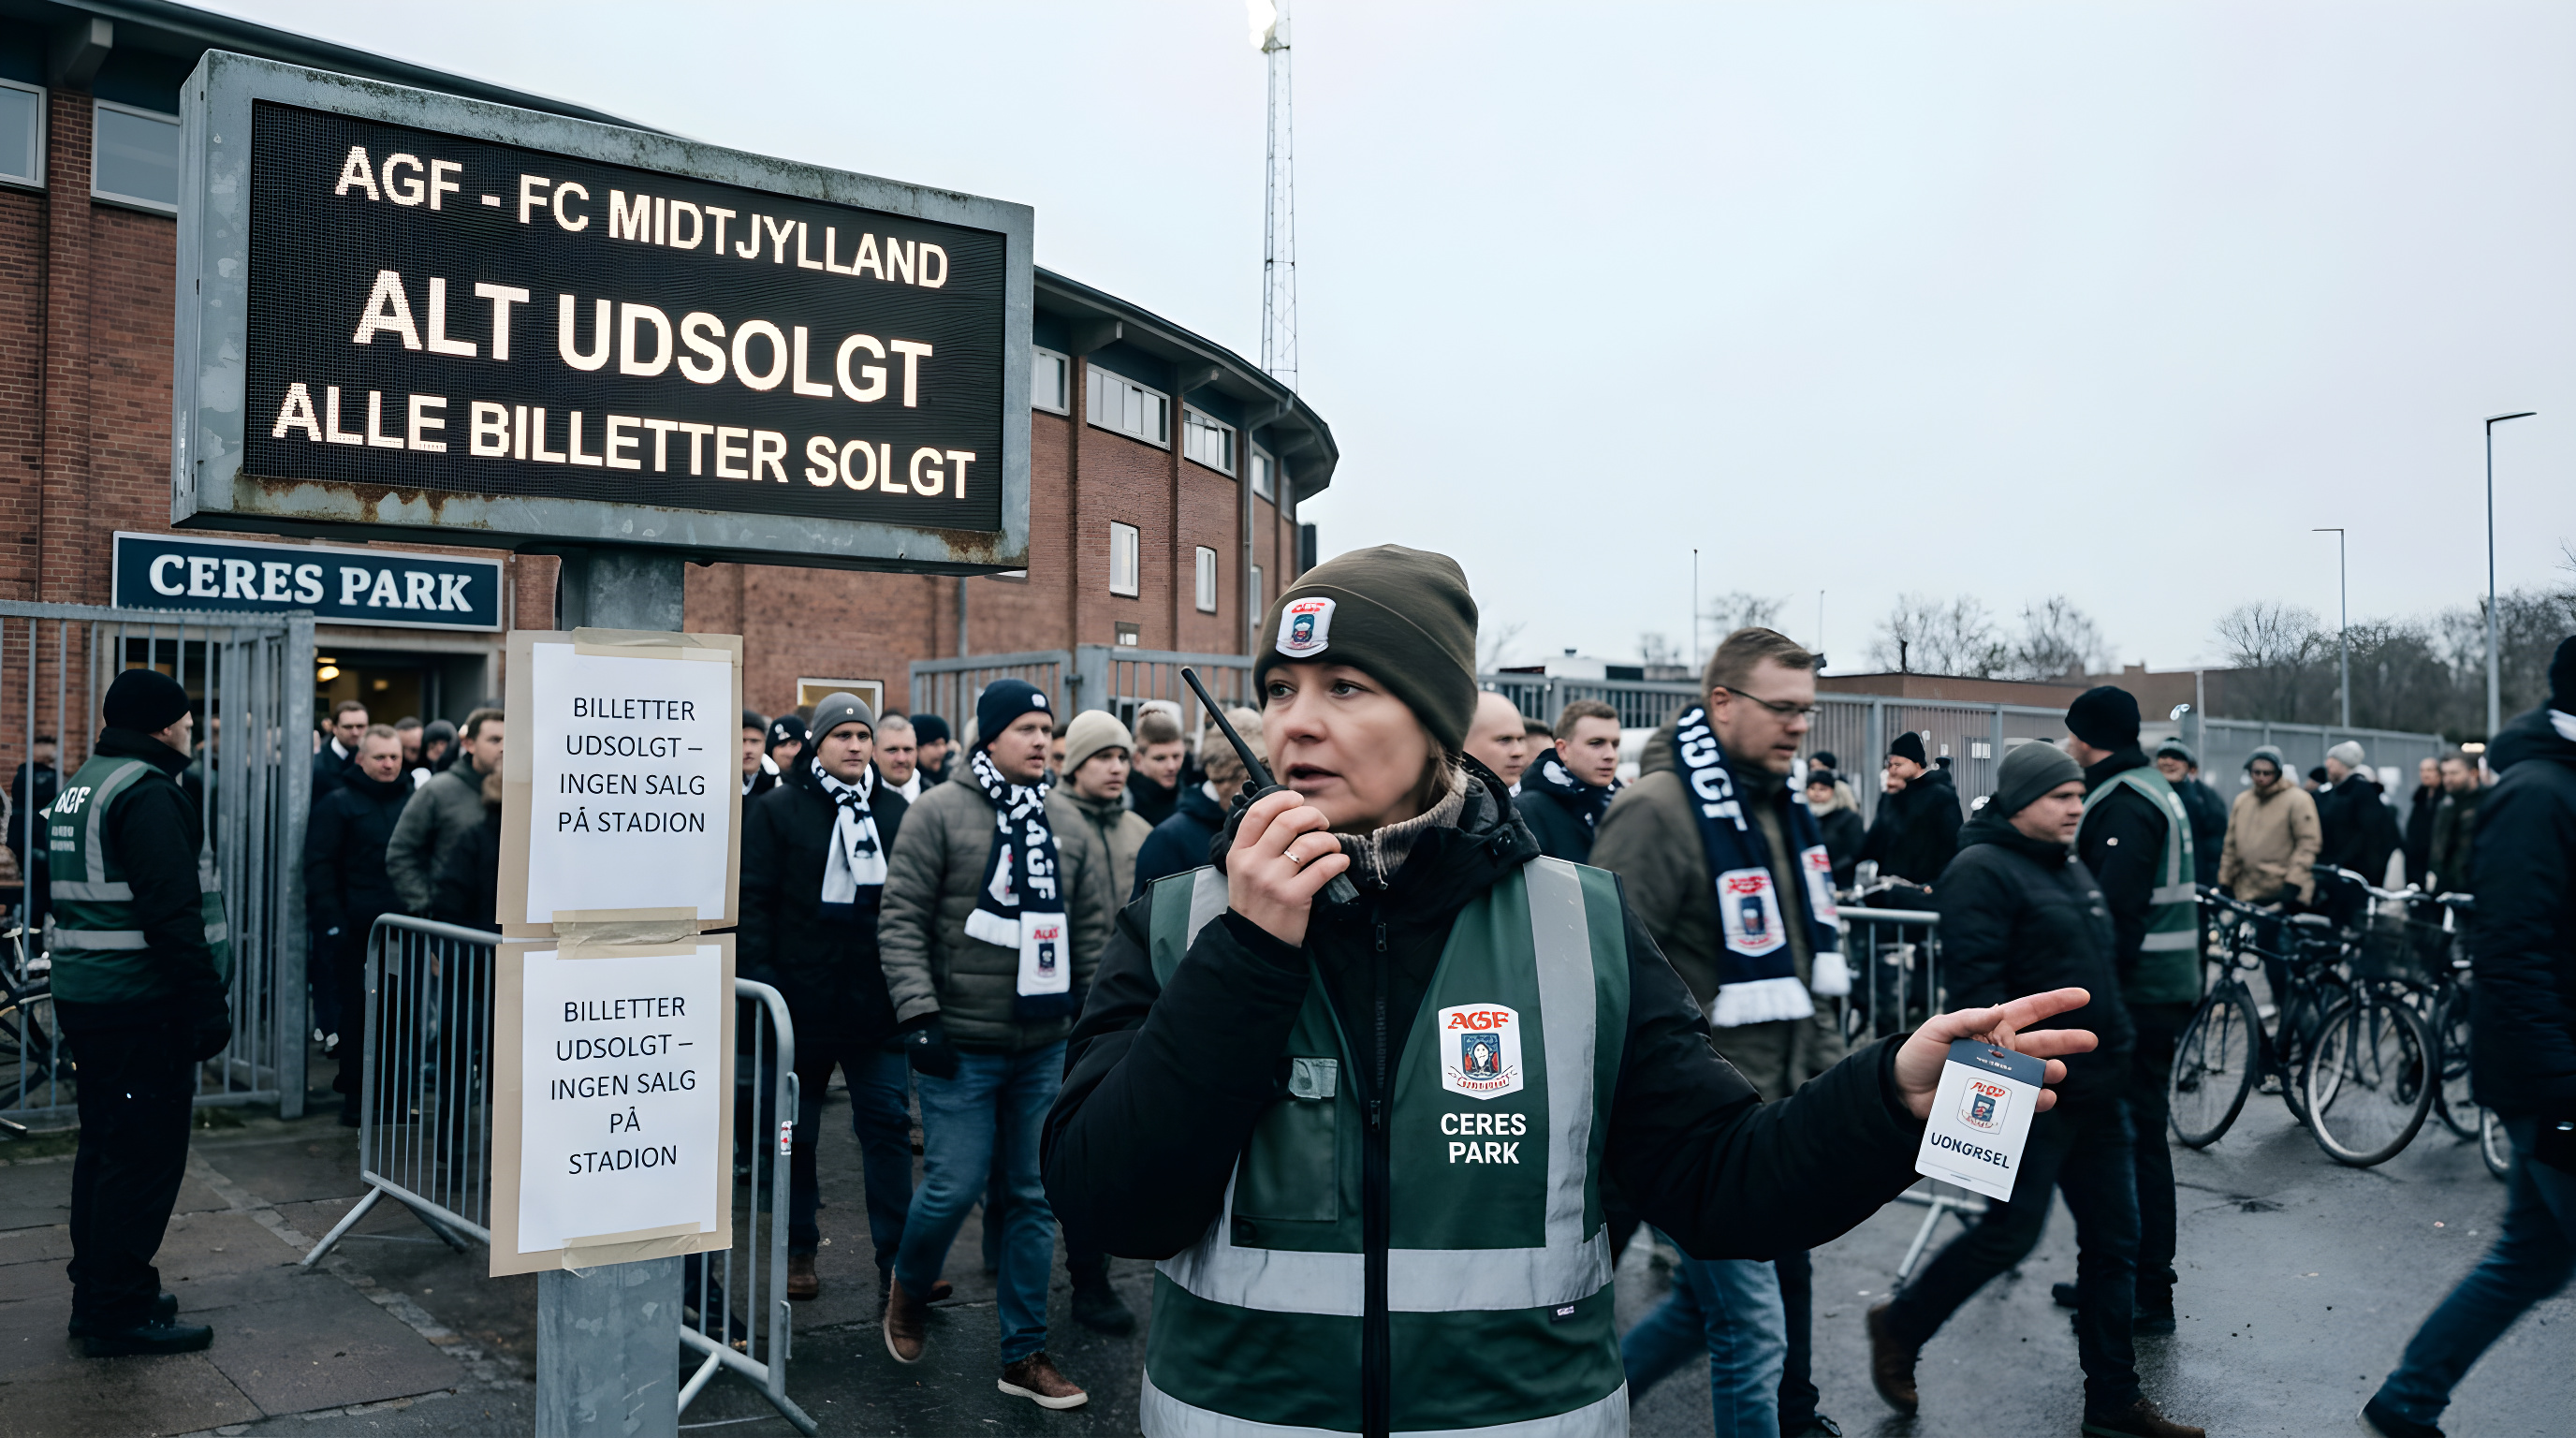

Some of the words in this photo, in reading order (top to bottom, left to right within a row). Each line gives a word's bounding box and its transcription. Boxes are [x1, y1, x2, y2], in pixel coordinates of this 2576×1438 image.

[334, 145, 462, 211] AGF
[481, 194, 501, 208] -
[520, 173, 590, 232] FC
[608, 189, 948, 289] MIDTJYLLAND
[353, 270, 530, 361] ALT
[558, 293, 933, 408] UDSOLGT
[271, 382, 447, 453] ALLE
[470, 401, 789, 483] BILLETTER
[805, 435, 976, 499] SOLGT
[149, 554, 324, 604] CERES
[339, 566, 473, 612] PARK
[574, 697, 695, 722] BILLETTER
[566, 734, 682, 758] UDSOLGT
[561, 773, 637, 795] INGEN
[645, 774, 705, 796] SALG
[558, 806, 590, 833] PÅ
[597, 812, 705, 833] STADION
[564, 996, 685, 1022] BILLETTER
[556, 1034, 673, 1062] UDSOLGT
[551, 1074, 628, 1101] INGEN
[637, 1069, 695, 1094] SALG
[610, 1106, 641, 1134] PÅ
[1441, 1112, 1527, 1136] CERES
[568, 1144, 677, 1175] STADION
[1448, 1141, 1520, 1165] PARK
